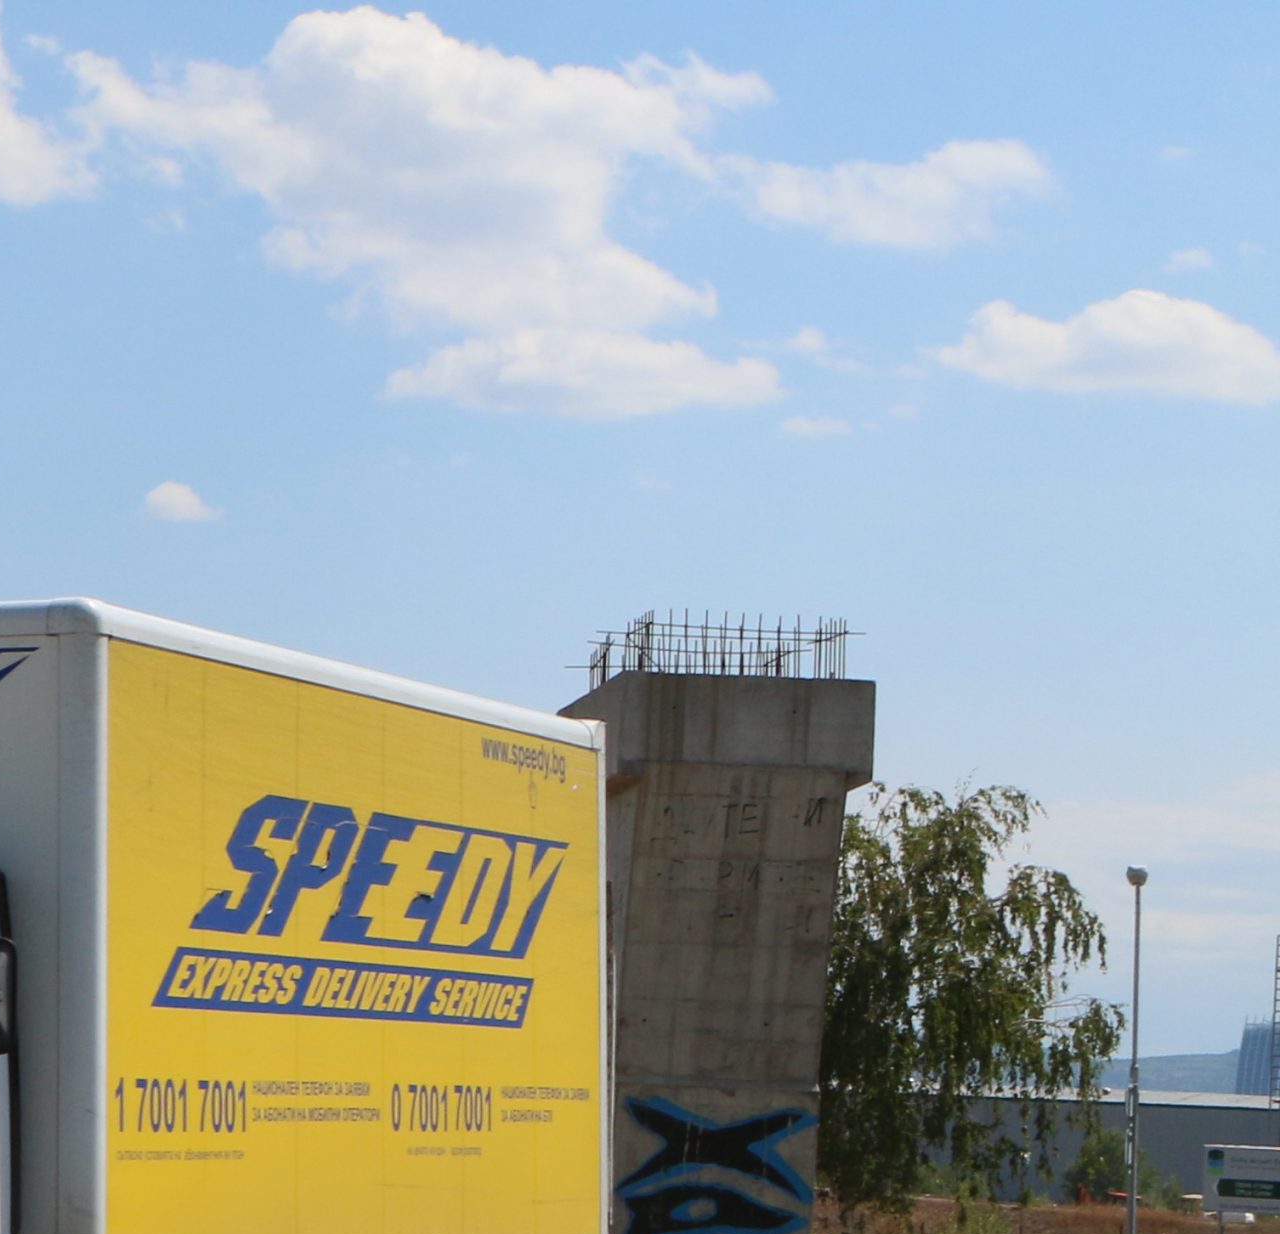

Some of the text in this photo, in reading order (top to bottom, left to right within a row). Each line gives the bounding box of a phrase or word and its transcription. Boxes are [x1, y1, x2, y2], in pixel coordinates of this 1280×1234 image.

[481, 736, 567, 783] www.speedy.bg
[189, 794, 571, 959] SPEEDY
[166, 954, 529, 1022] EXPRESS DELIVERY SERVICE
[115, 1077, 247, 1133] 1 7001 7001
[391, 1083, 492, 1133] 0 7001 7001
